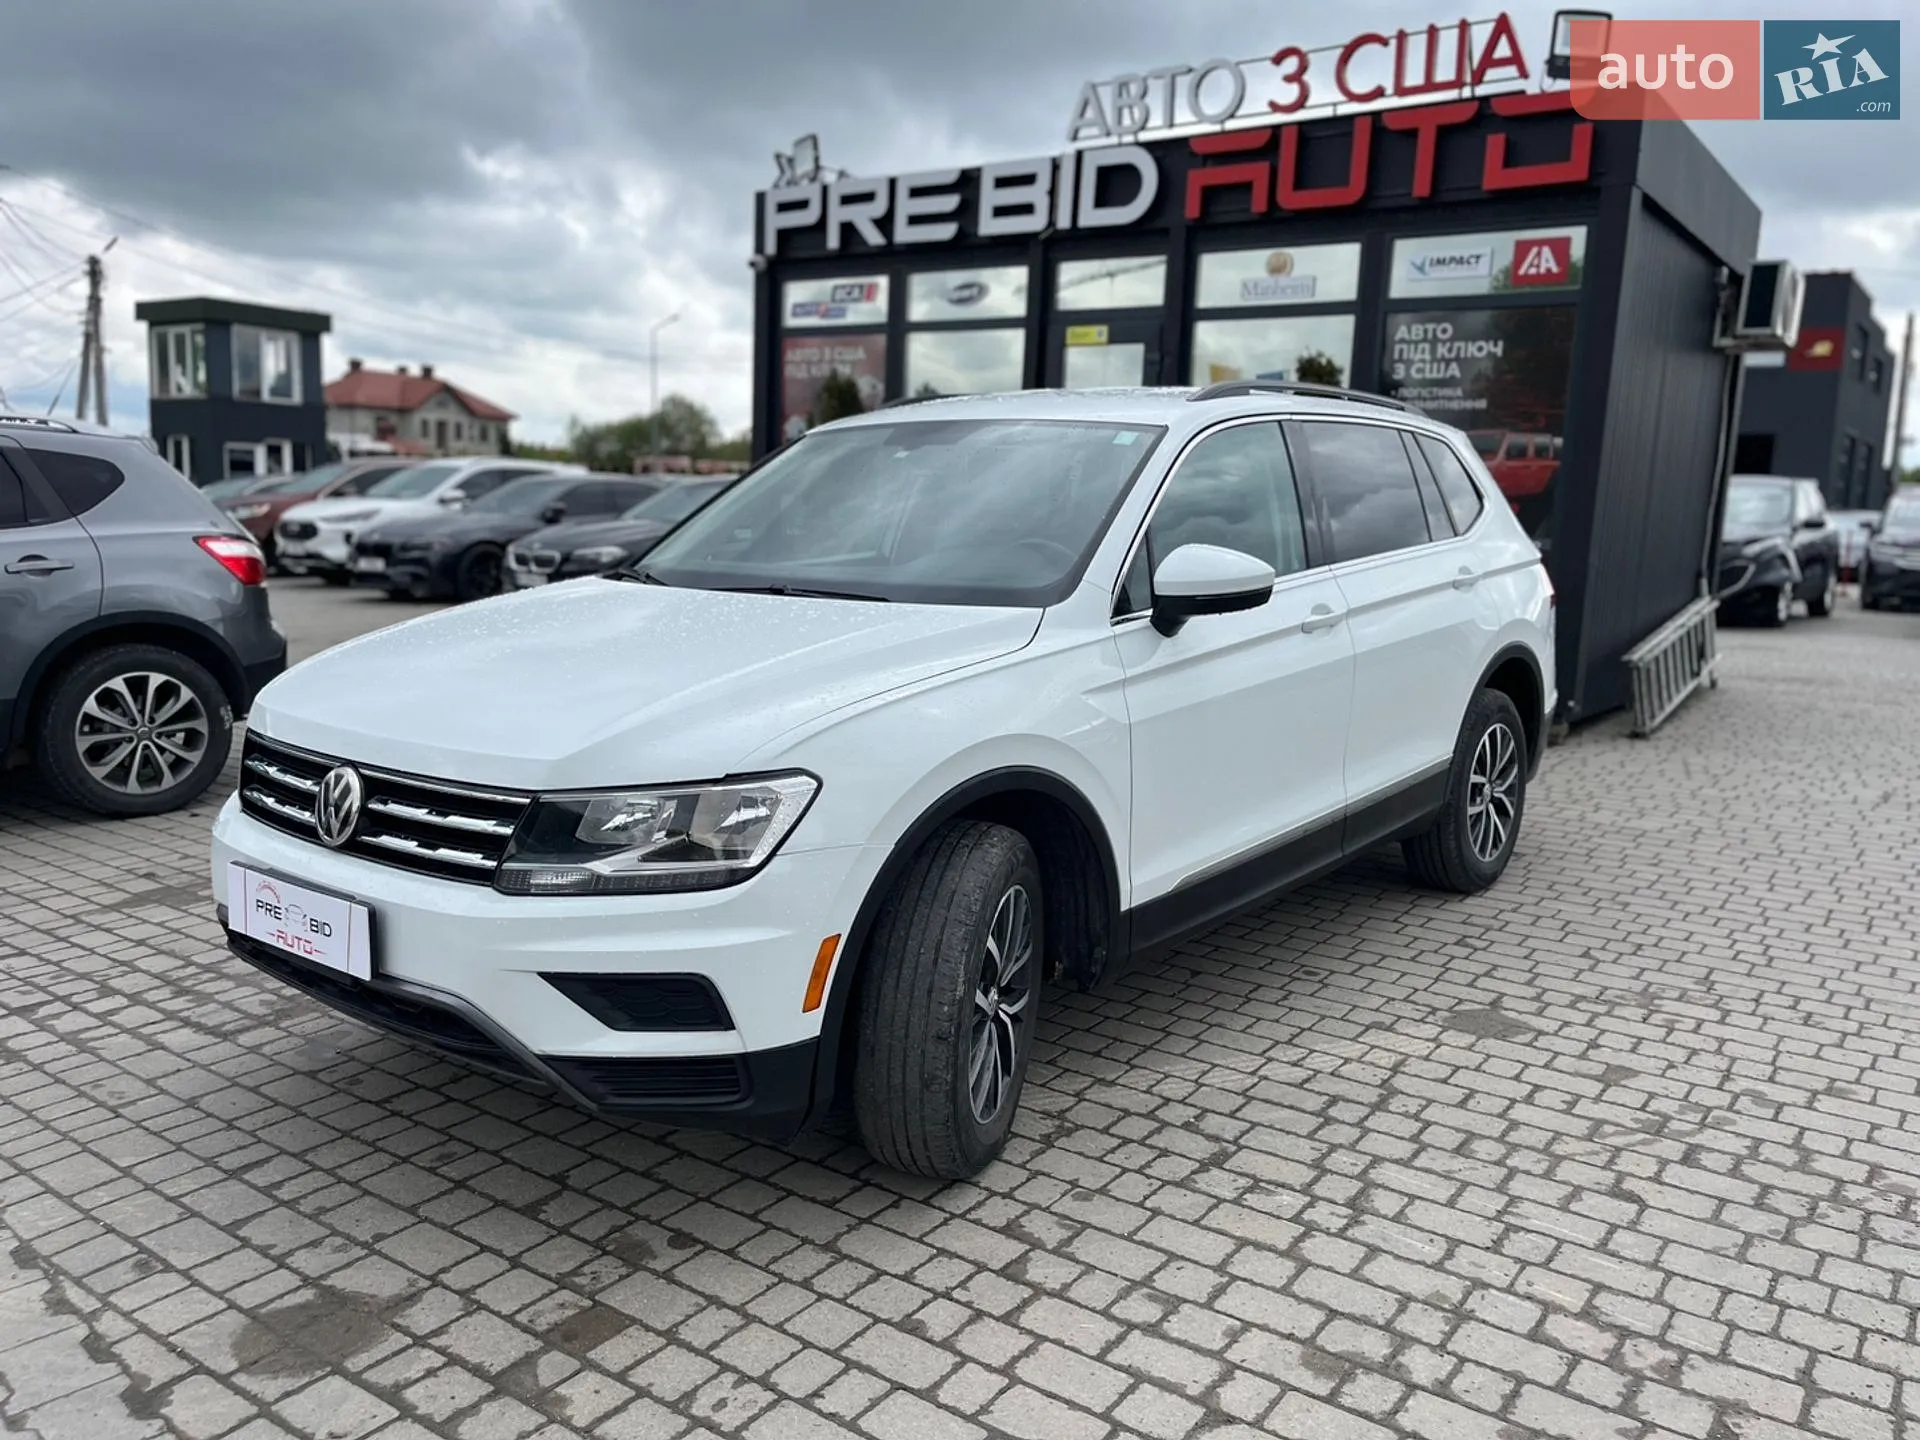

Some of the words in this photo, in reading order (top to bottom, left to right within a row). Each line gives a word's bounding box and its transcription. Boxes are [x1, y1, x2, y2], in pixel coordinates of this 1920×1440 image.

[1067, 58, 1245, 140] АВТО
[1267, 46, 1310, 113] З
[1336, 12, 1529, 102] США
[1184, 84, 1597, 220] AUTO
[1394, 323, 1453, 341] АВТО
[1393, 343, 1431, 361] ПІД
[1436, 340, 1504, 360] КЛЮЧ
[1410, 361, 1461, 379] США
[256, 899, 282, 921] PRE
[309, 918, 332, 938] BID
[276, 929, 313, 955] AUTO
